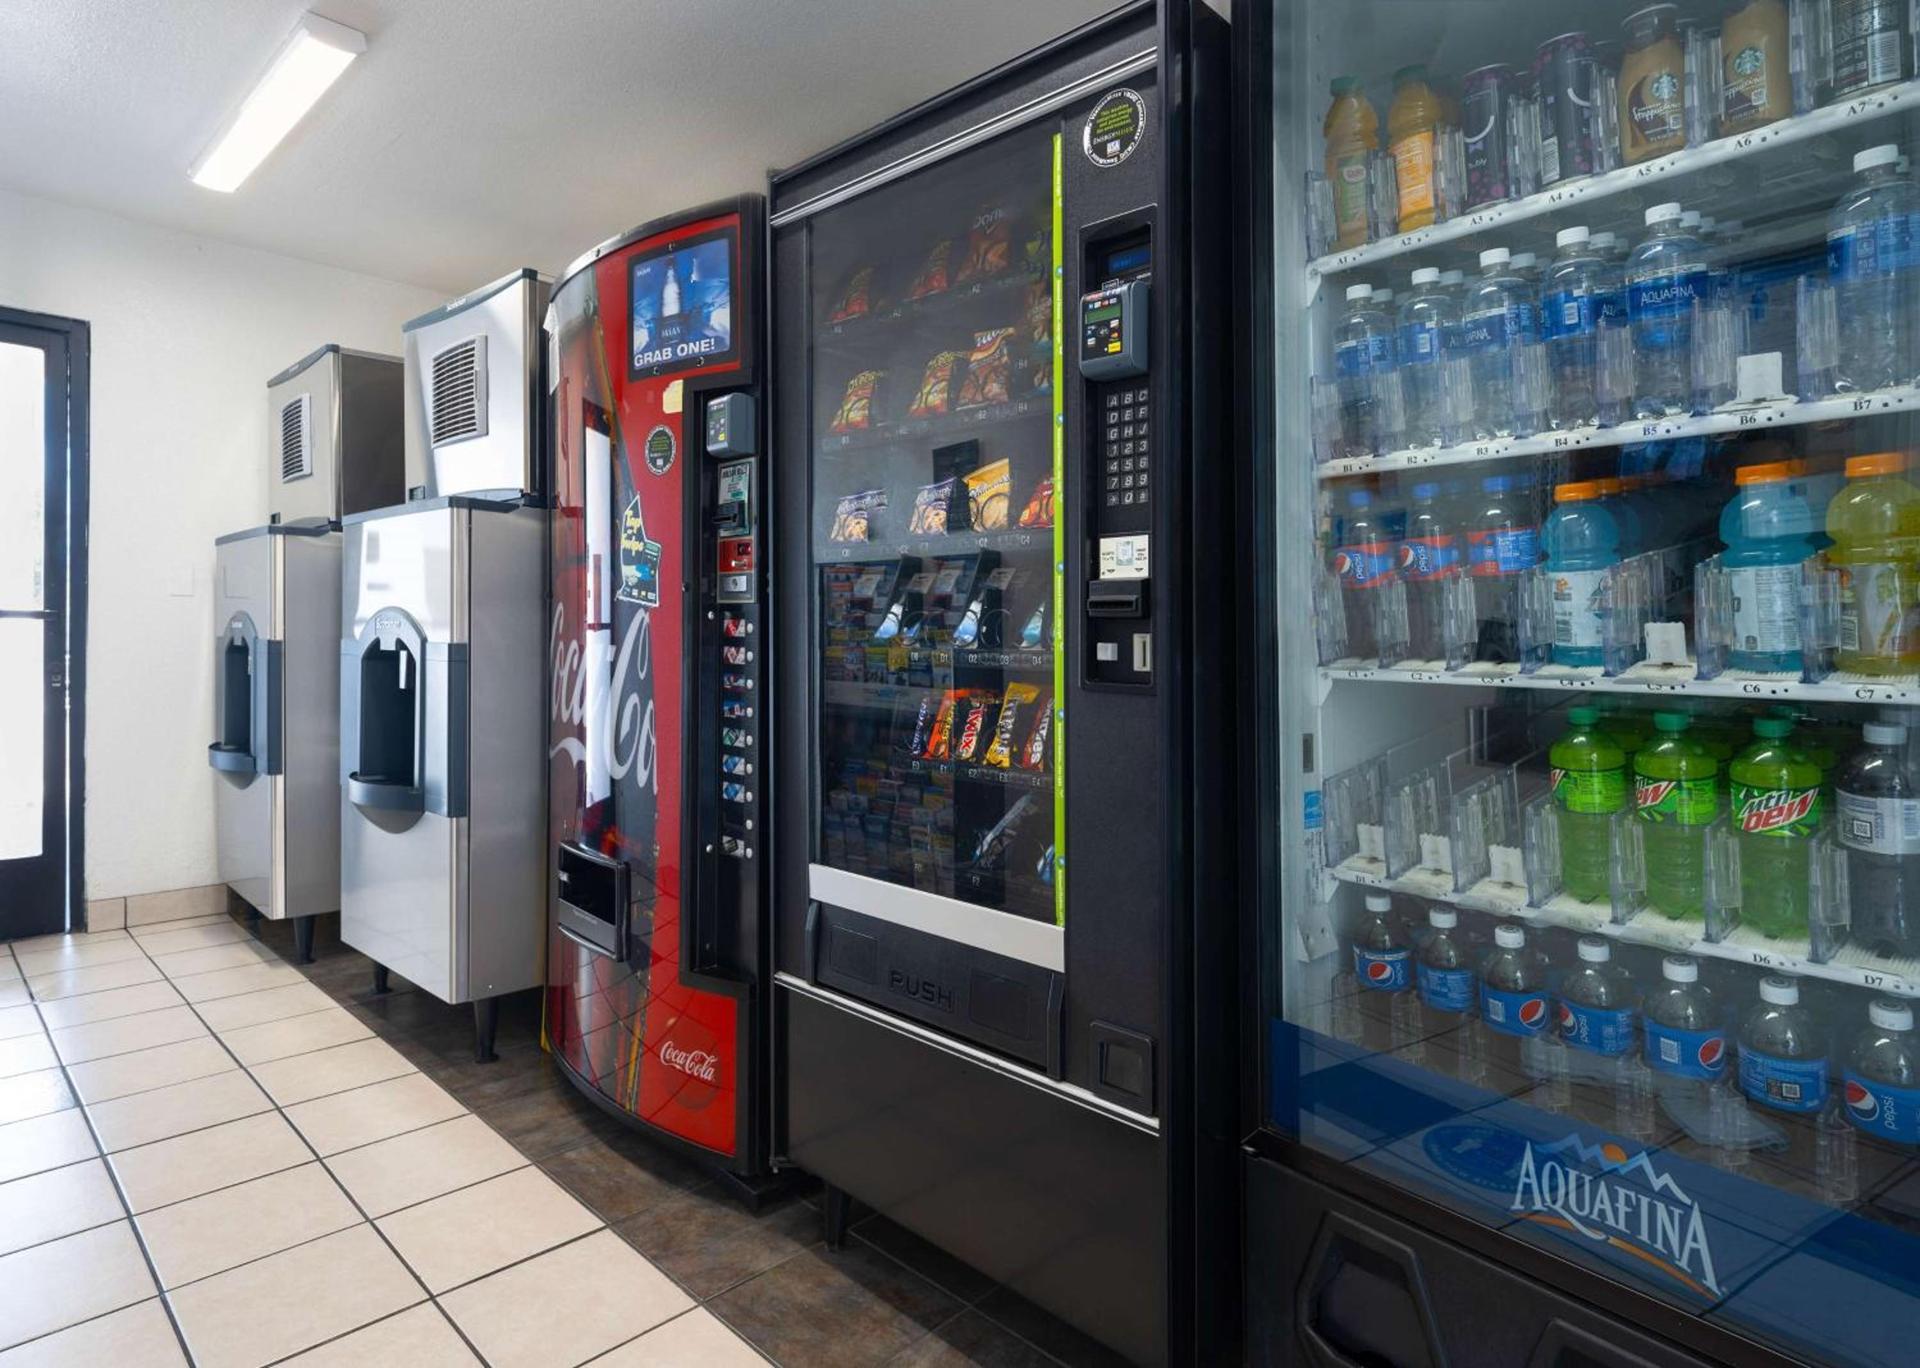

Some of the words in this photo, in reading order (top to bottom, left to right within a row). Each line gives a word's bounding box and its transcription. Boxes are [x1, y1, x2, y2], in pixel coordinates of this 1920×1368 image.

[1847, 102, 1866, 116] A7
[1734, 138, 1752, 151] A6
[1470, 215, 1484, 226] A3
[1641, 284, 1695, 306] AQUAFINA
[634, 347, 672, 367] GRAB
[677, 338, 715, 356] ONE!
[1853, 399, 1872, 412] B7
[1740, 415, 1757, 425] B6
[1642, 426, 1657, 436] B5
[1554, 437, 1568, 447] B4
[1476, 447, 1488, 456] B3
[1407, 456, 1418, 465] B2
[1743, 684, 1760, 694] C6
[1855, 689, 1875, 700] C7
[1753, 953, 1771, 966] D6
[1864, 974, 1884, 987] D7
[660, 1040, 718, 1081] Coca-Cola
[1884, 1094, 1899, 1131] pepsi
[1510, 1140, 1721, 1296] AQUAFINA
